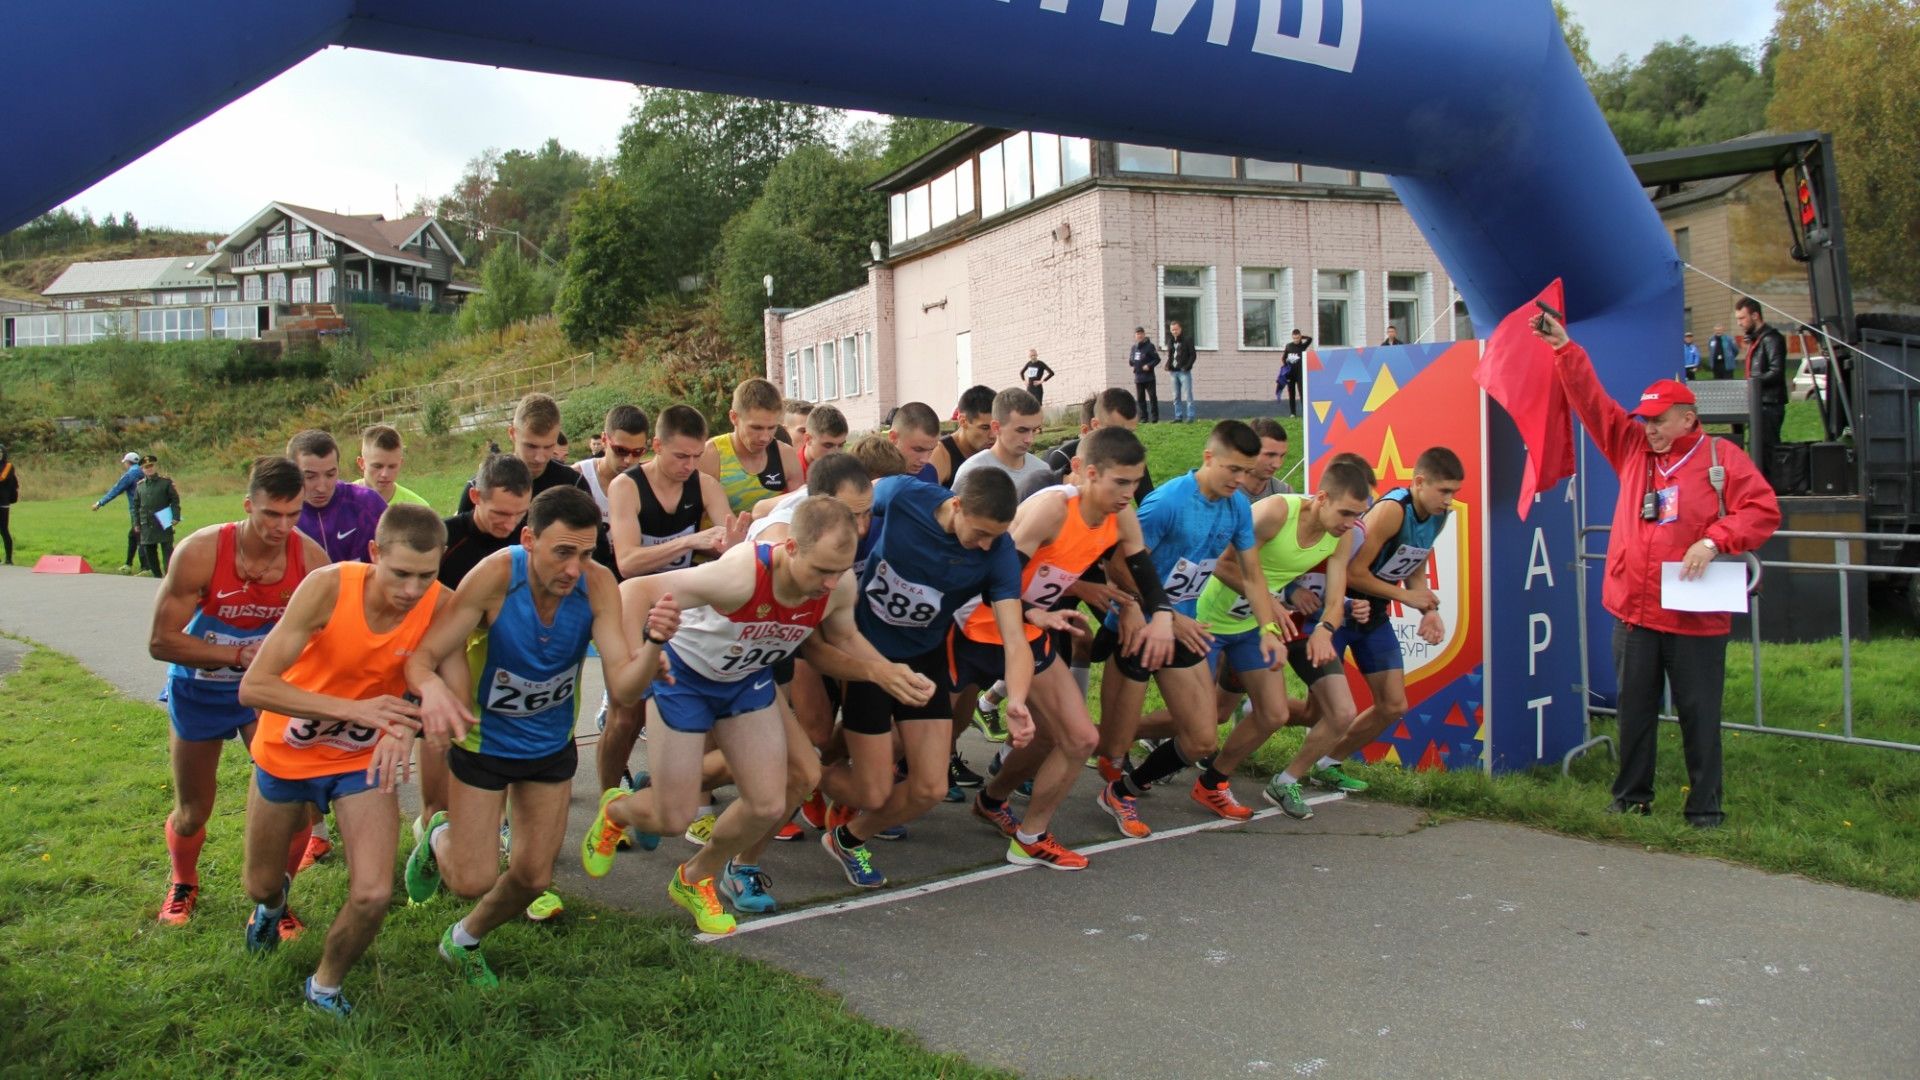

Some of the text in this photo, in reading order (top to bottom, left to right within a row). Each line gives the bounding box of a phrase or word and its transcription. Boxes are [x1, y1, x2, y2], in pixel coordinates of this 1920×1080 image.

[866, 575, 935, 622] 288
[738, 624, 805, 642] RUSSIA
[721, 648, 787, 671] 790
[491, 677, 574, 711] 266
